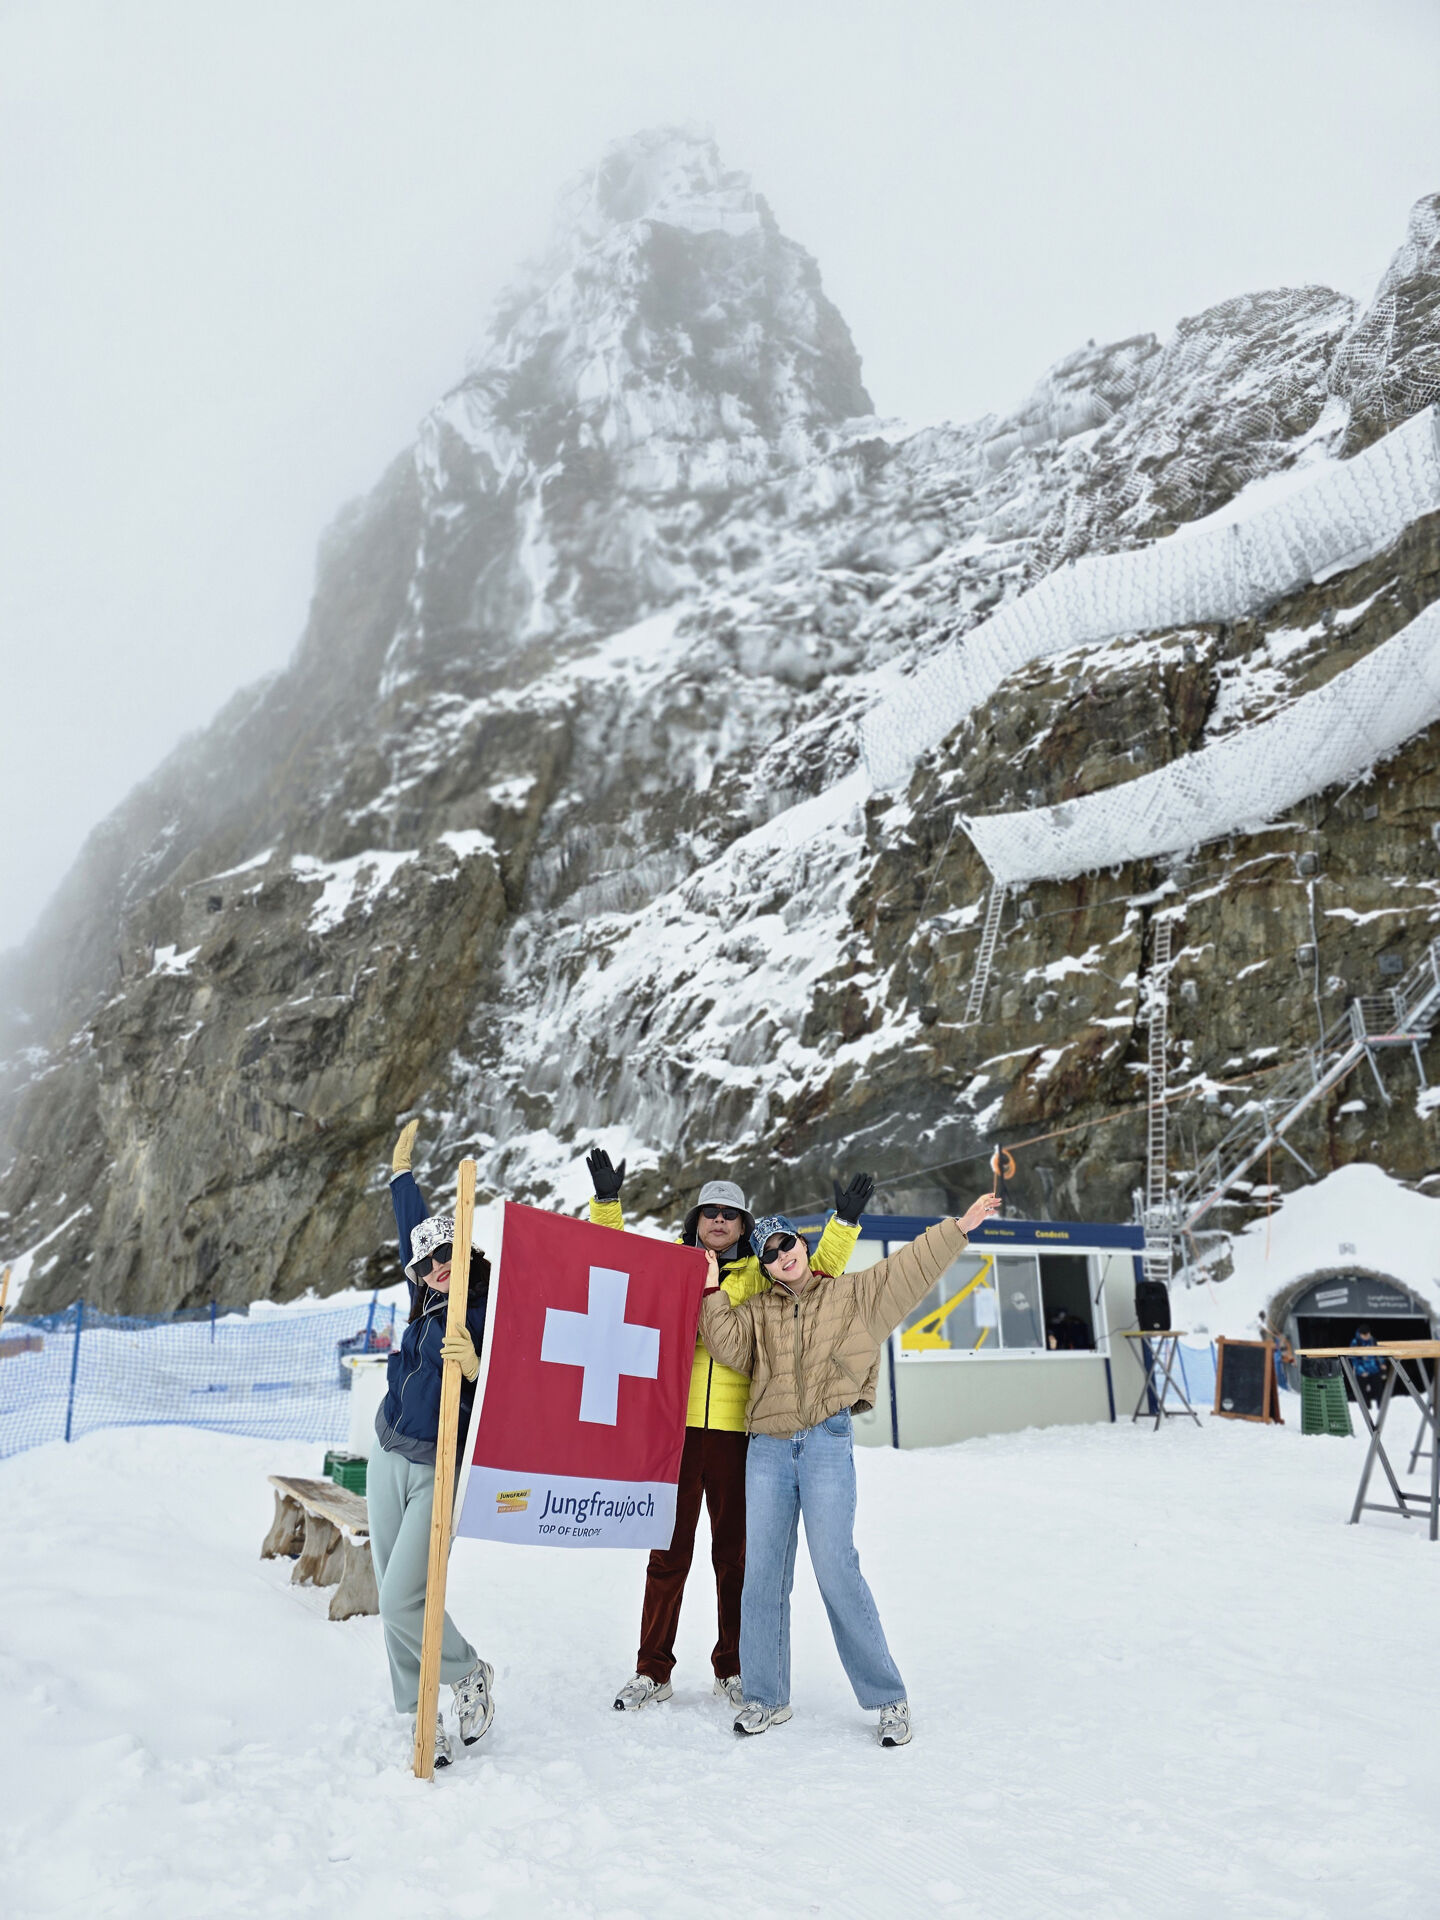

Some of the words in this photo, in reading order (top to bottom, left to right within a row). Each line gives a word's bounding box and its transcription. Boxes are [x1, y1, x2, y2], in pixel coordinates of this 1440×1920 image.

[539, 1490, 655, 1523] Jungfraujoch
[539, 1524, 556, 1534] TOP
[557, 1526, 571, 1535] OF
[572, 1527, 602, 1537] EUROPE
